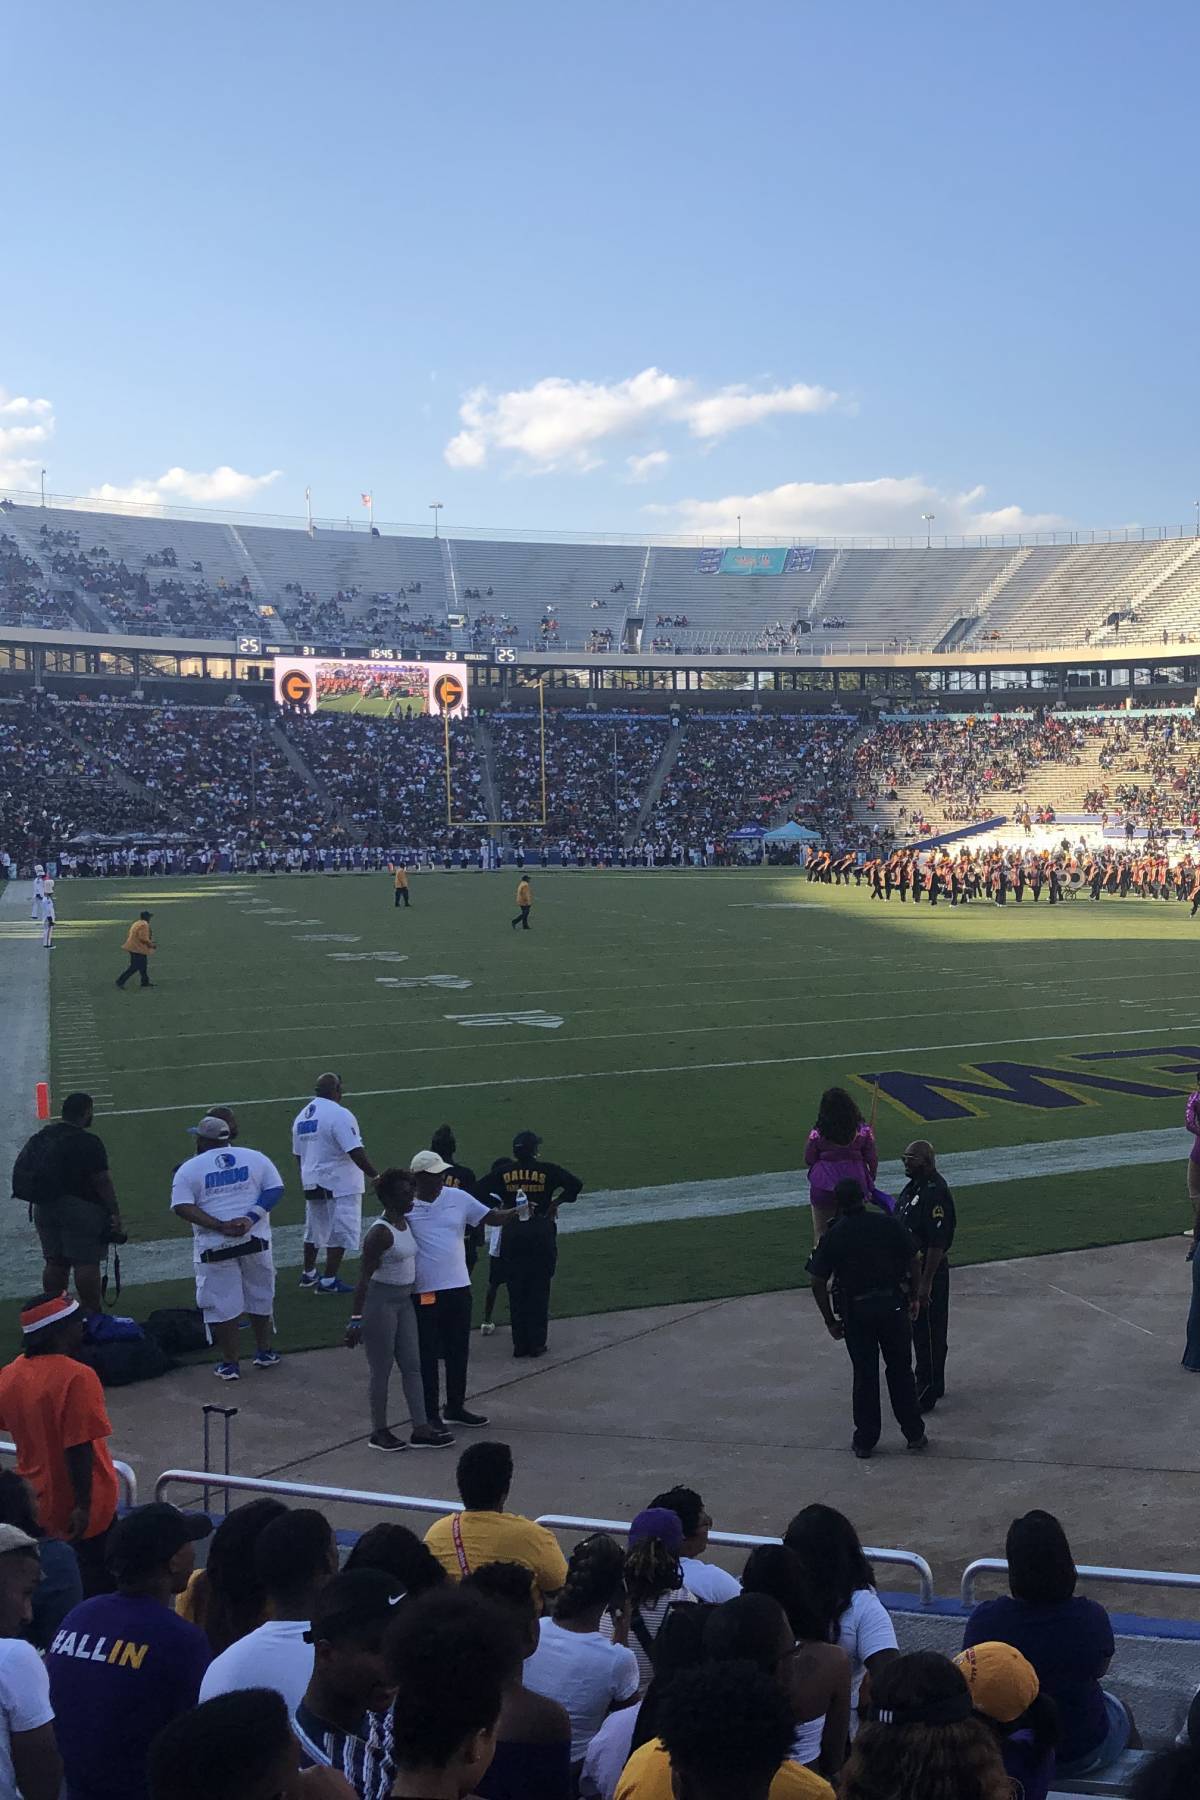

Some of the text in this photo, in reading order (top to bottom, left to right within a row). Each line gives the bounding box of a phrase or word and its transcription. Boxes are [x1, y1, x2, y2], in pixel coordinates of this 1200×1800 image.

[240, 639, 259, 652] 25
[445, 651, 457, 661] 23
[498, 650, 515, 662] 25
[503, 1168, 547, 1184] DALLAS
